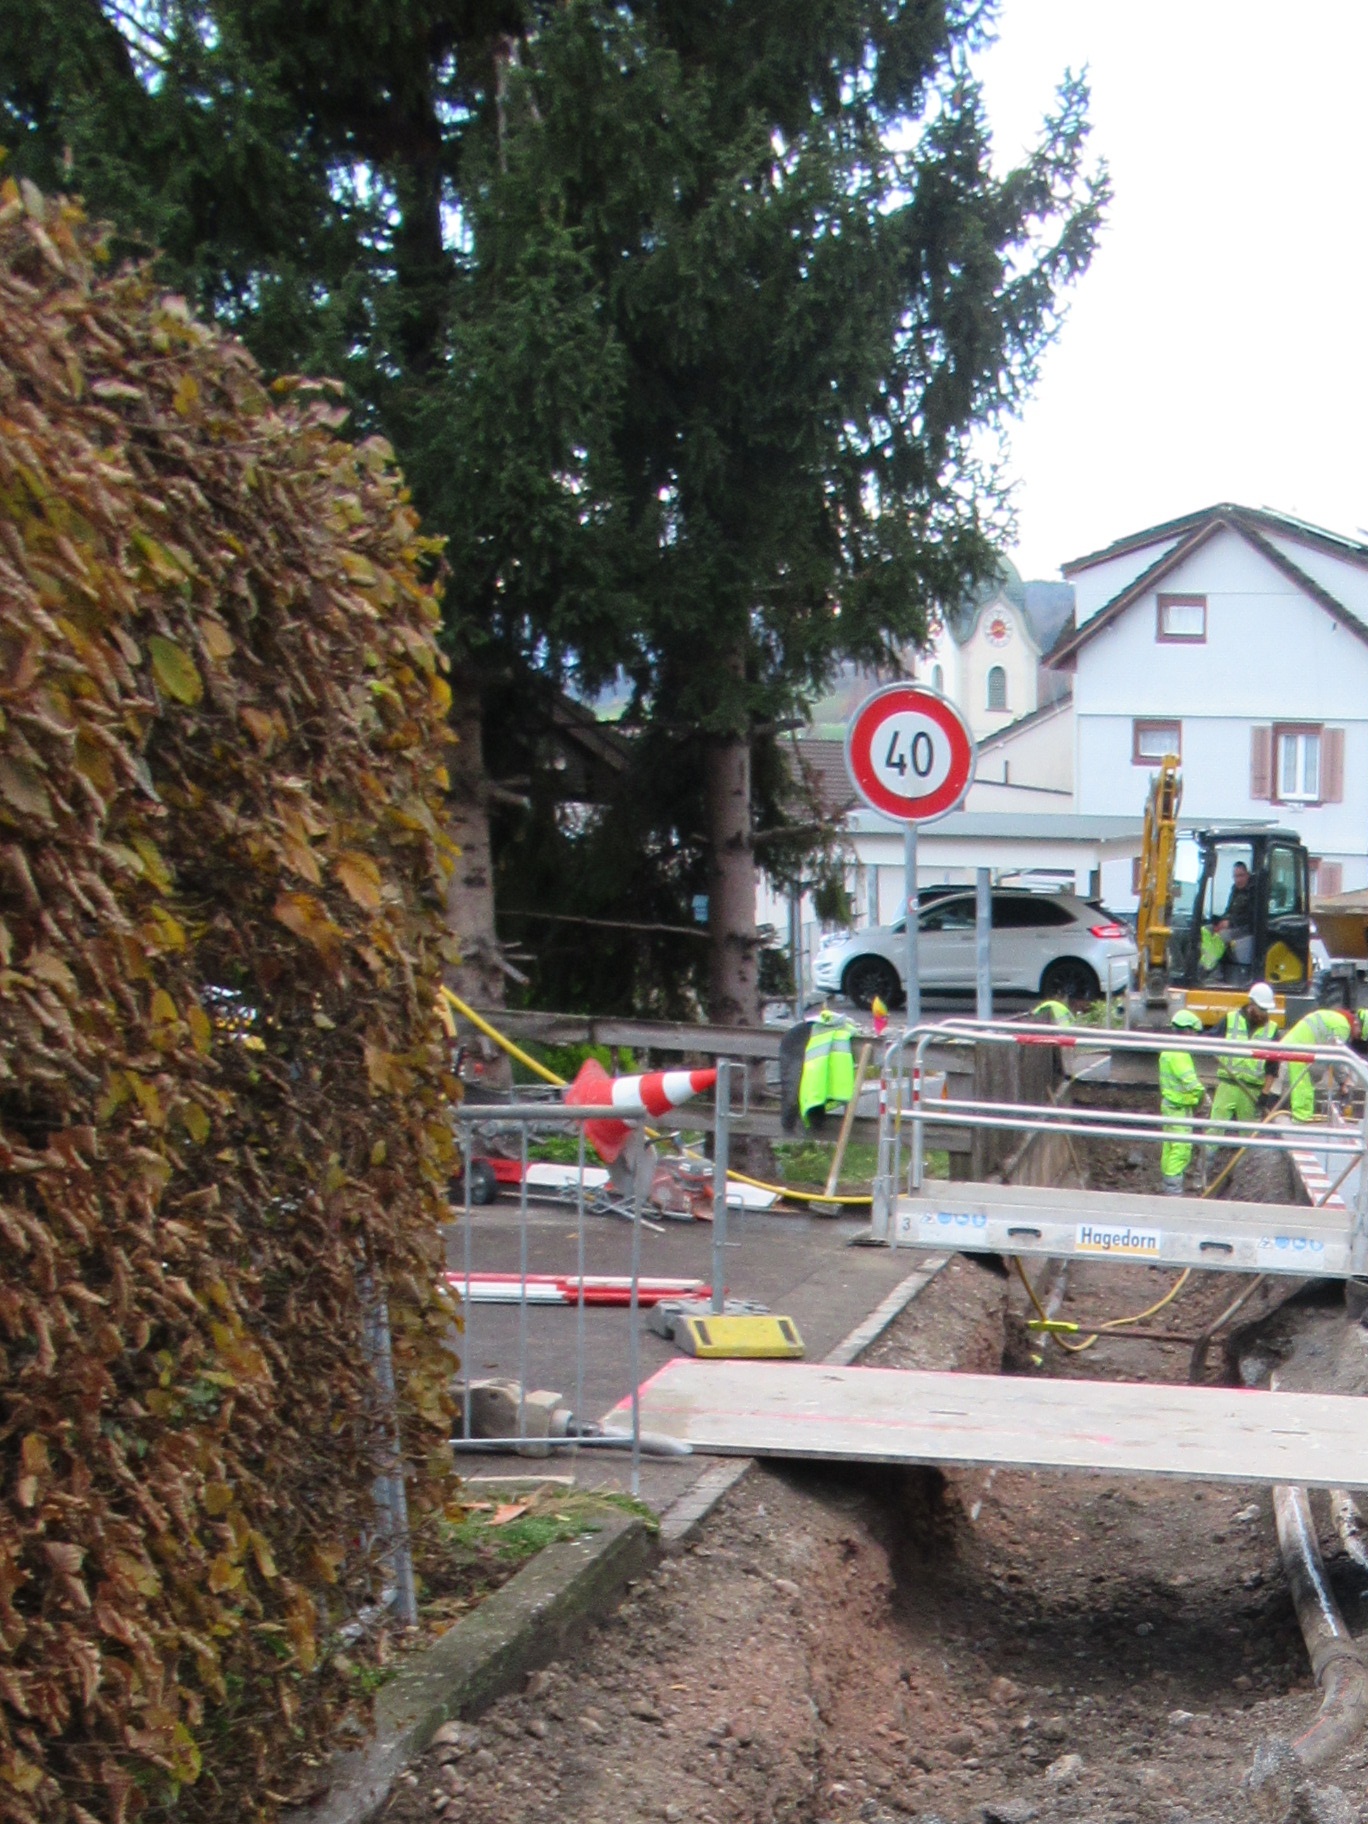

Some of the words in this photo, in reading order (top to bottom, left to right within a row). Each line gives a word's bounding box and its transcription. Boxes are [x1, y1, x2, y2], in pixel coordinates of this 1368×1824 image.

[885, 731, 934, 777] 40
[902, 1217, 911, 1231] 3
[1080, 1226, 1157, 1250] Hagedorn
